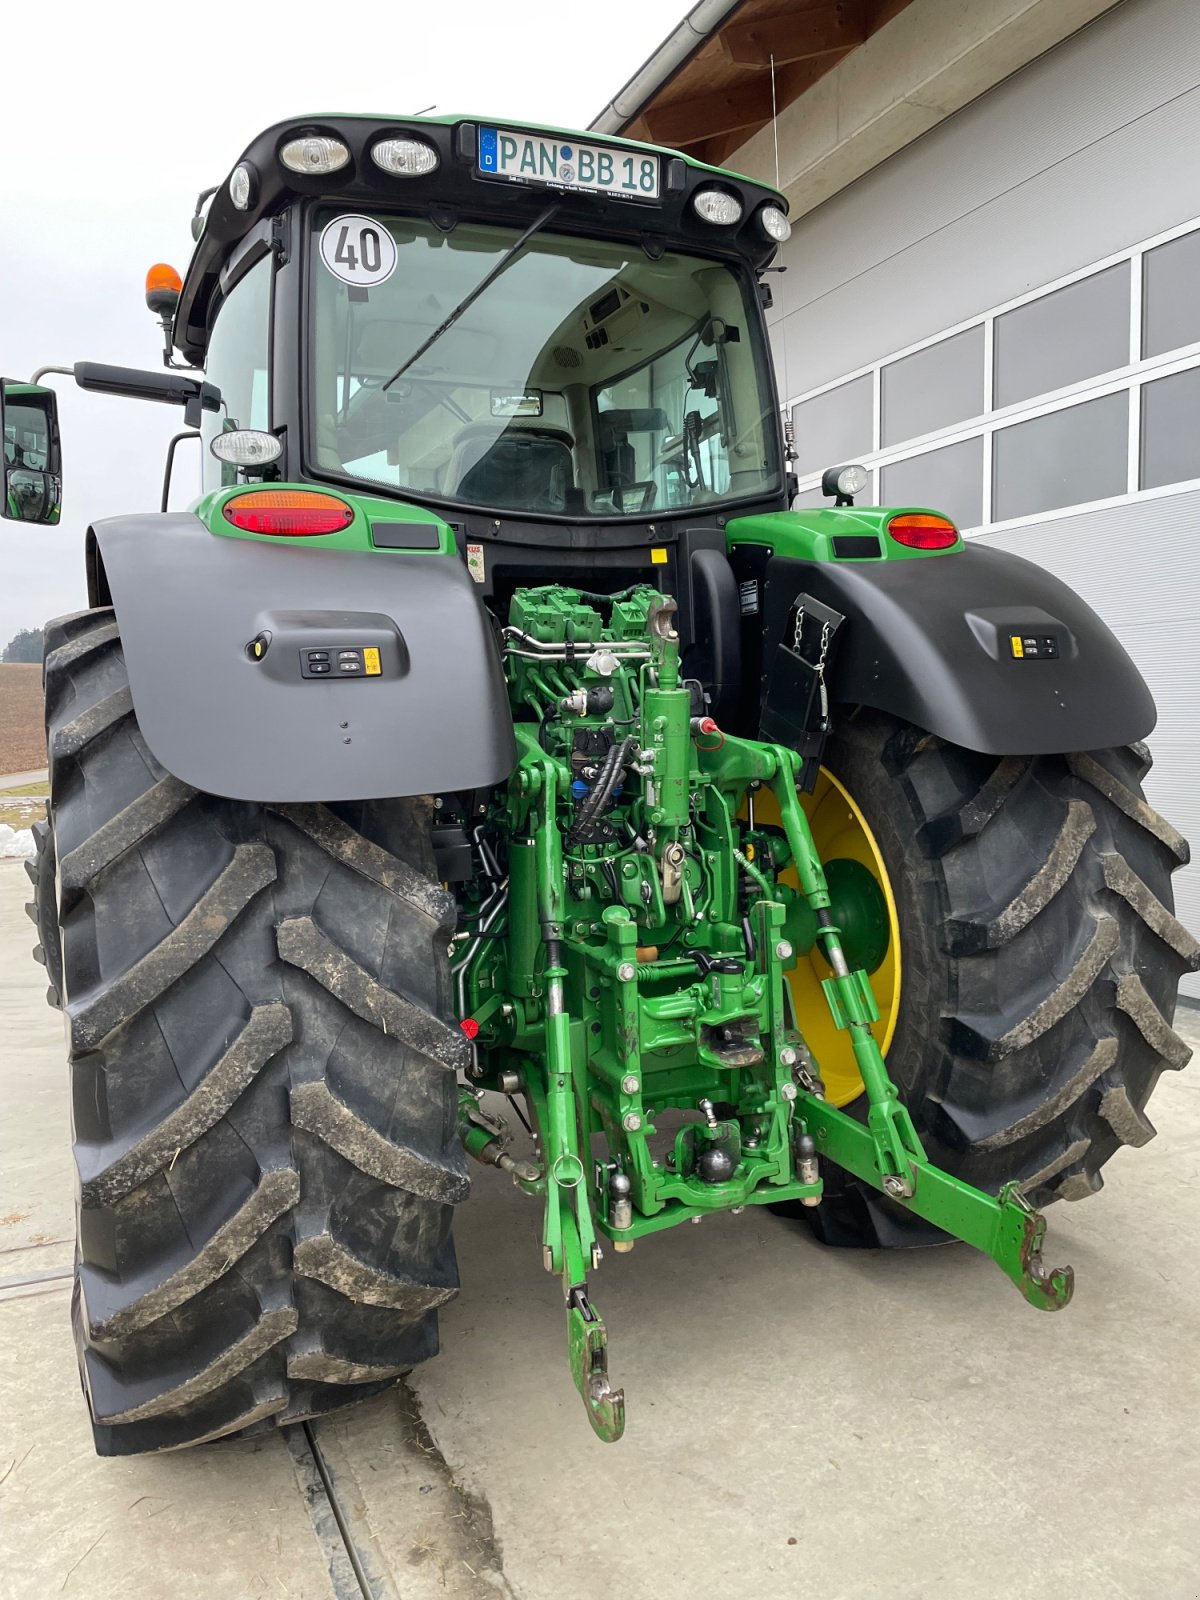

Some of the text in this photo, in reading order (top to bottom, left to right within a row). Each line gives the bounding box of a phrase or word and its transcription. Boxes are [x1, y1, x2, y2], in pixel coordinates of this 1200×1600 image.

[485, 155, 493, 165] D
[500, 136, 655, 192] PAN BB 18
[334, 226, 381, 272] 40
